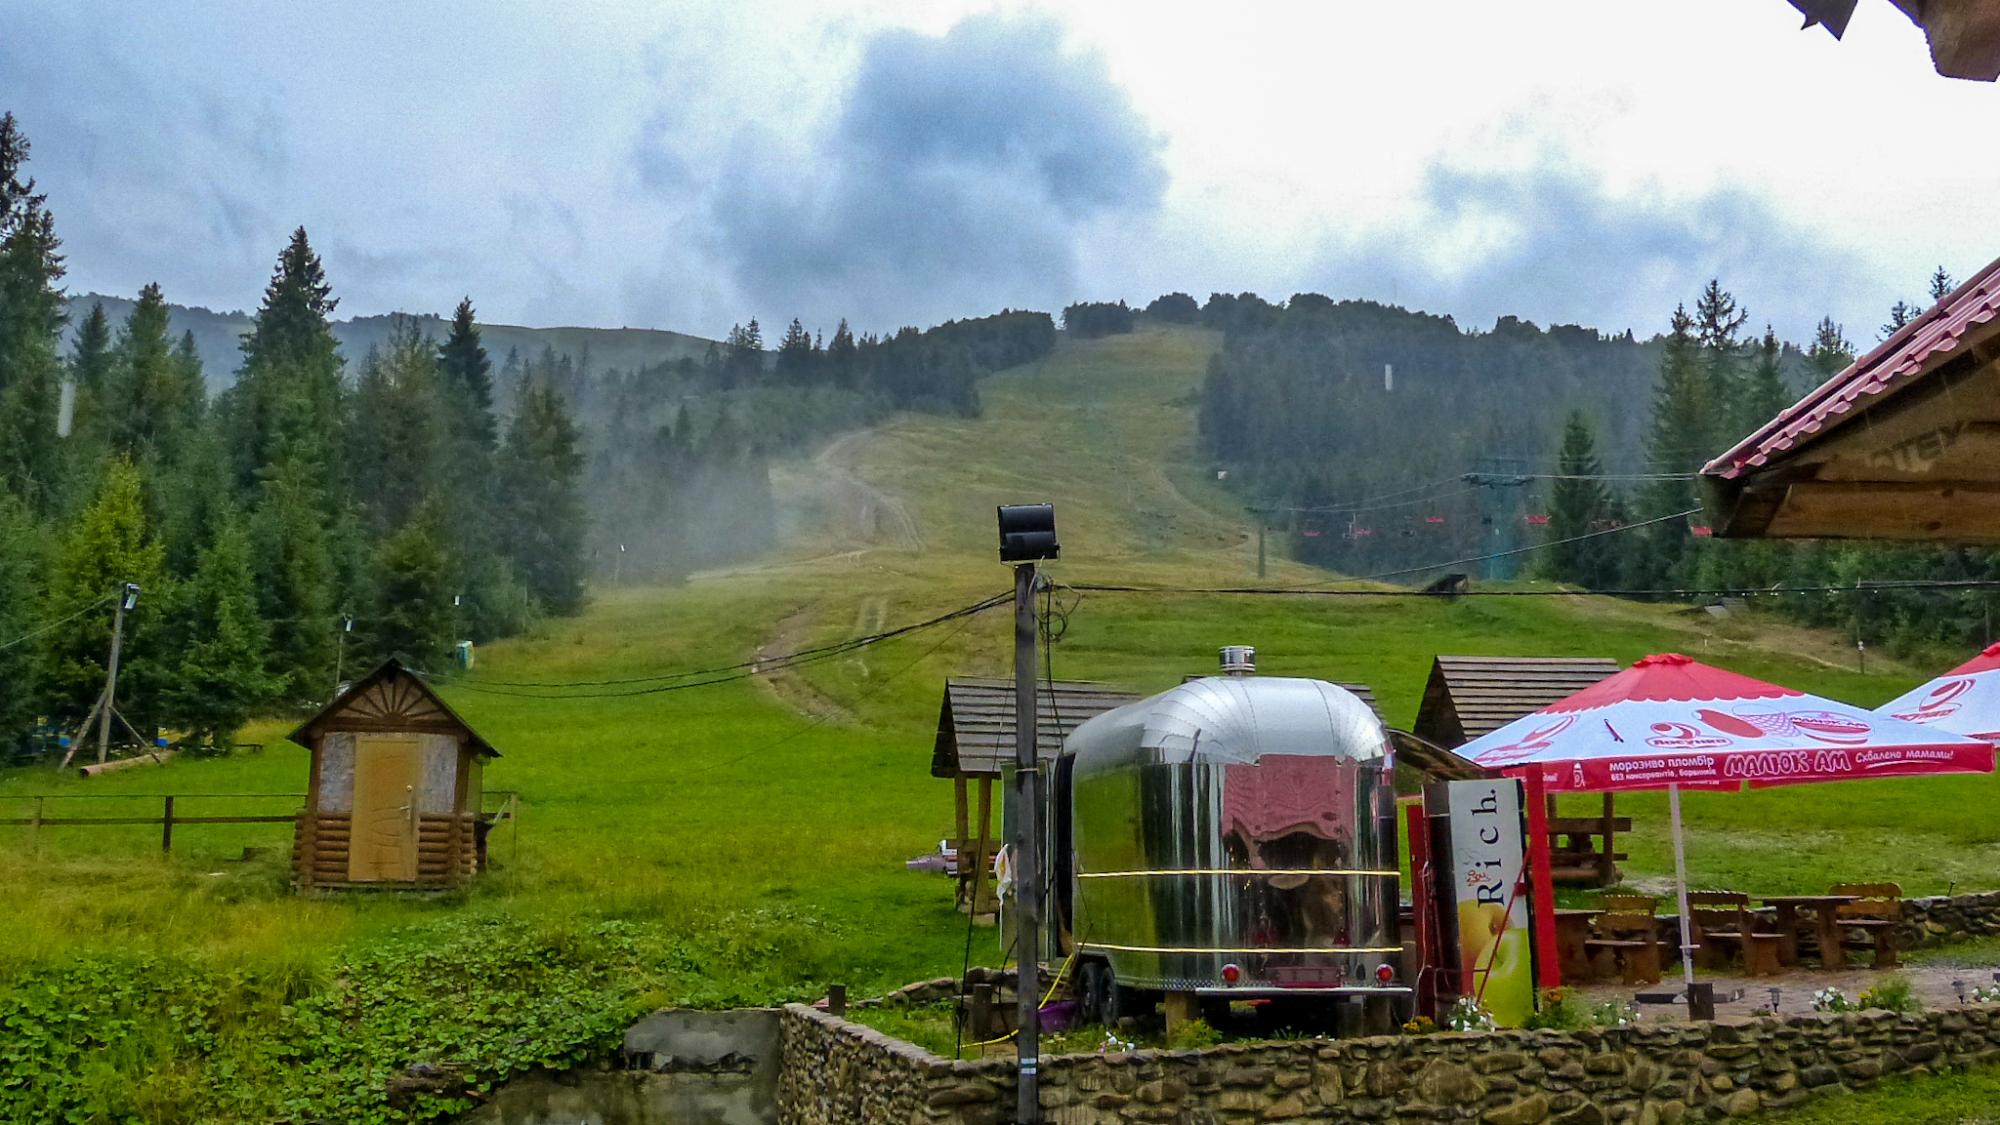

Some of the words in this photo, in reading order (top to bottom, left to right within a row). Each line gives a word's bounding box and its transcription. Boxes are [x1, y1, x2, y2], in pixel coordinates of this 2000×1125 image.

[1609, 758, 1665, 771] морозиво
[1668, 756, 1714, 769] пломбір
[1855, 751, 1901, 763] Схвалено
[1906, 750, 1954, 760] мамами!
[1725, 752, 1851, 777] МАЛЮК-АМ
